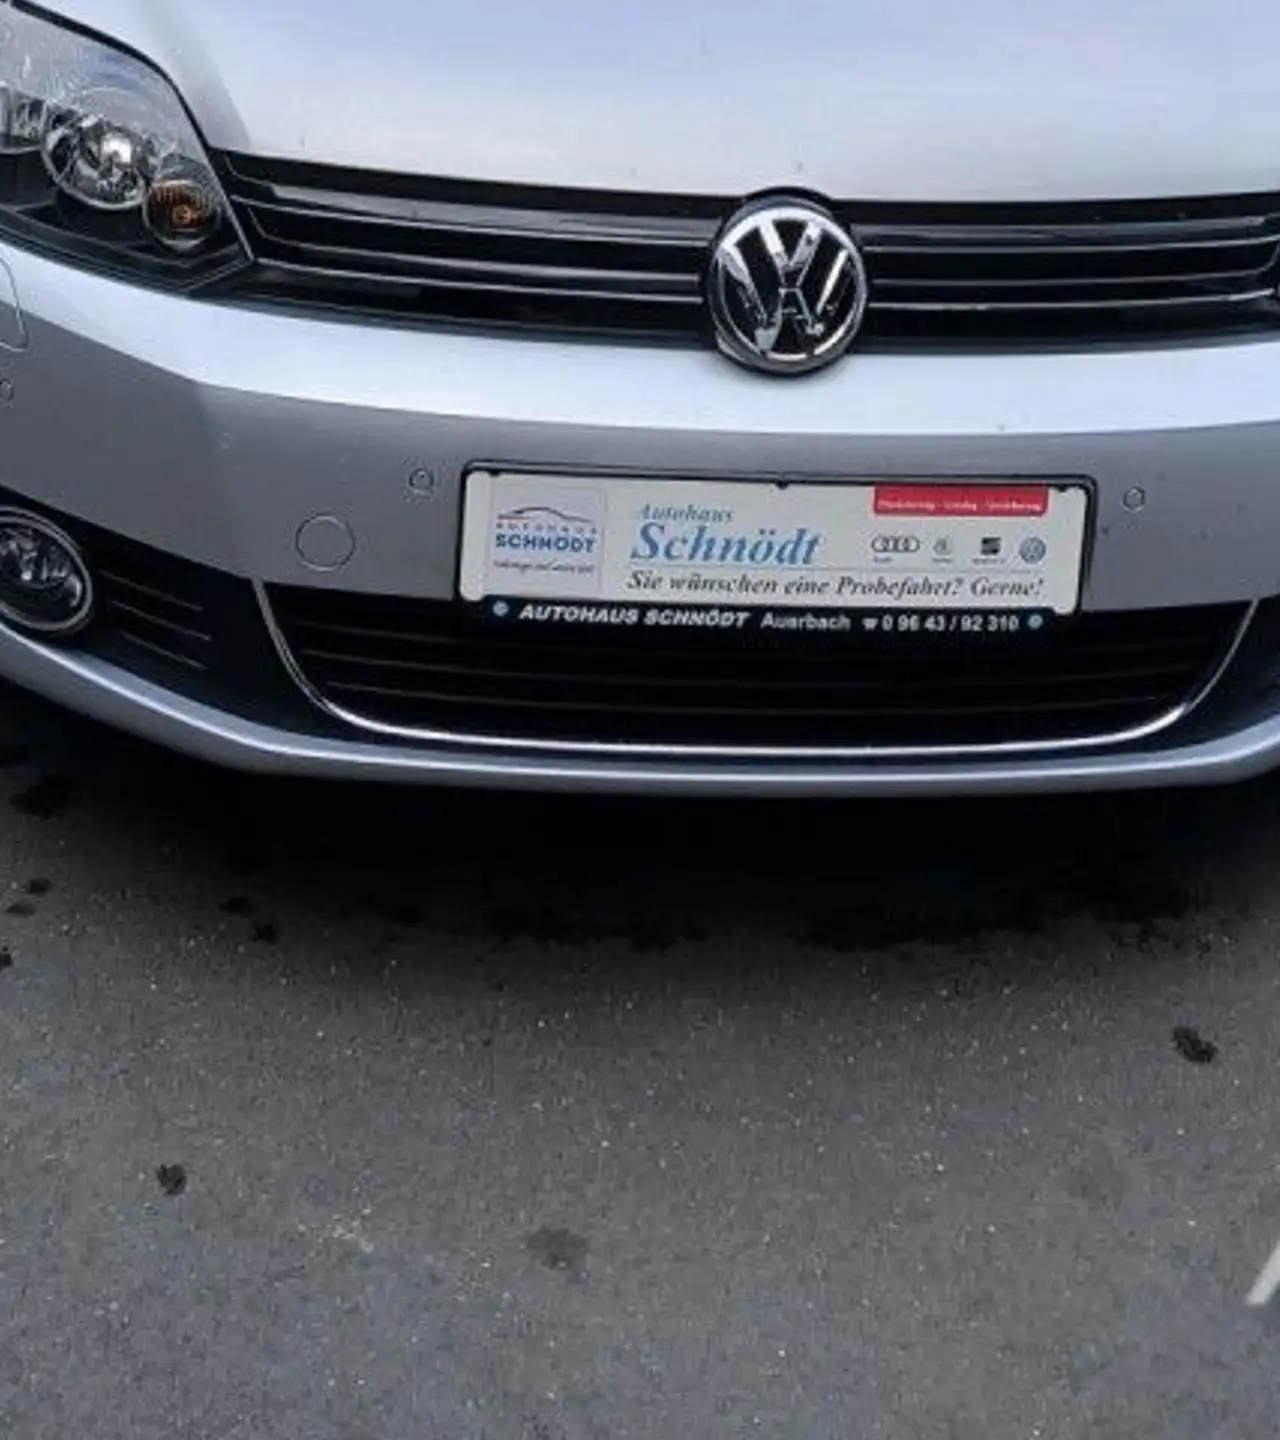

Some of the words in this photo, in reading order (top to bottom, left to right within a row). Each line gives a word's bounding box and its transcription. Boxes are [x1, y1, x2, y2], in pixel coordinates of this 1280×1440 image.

[639, 504, 735, 522] Autohaus
[630, 522, 821, 564] Schnödt
[626, 570, 662, 589] Sie
[669, 571, 777, 594] wünschen
[782, 576, 830, 596] eine
[836, 575, 964, 601] Probefahrt?
[970, 576, 1045, 598] Gerne!
[519, 603, 639, 626] AUTOHAUS
[760, 612, 851, 632] Auerbach
